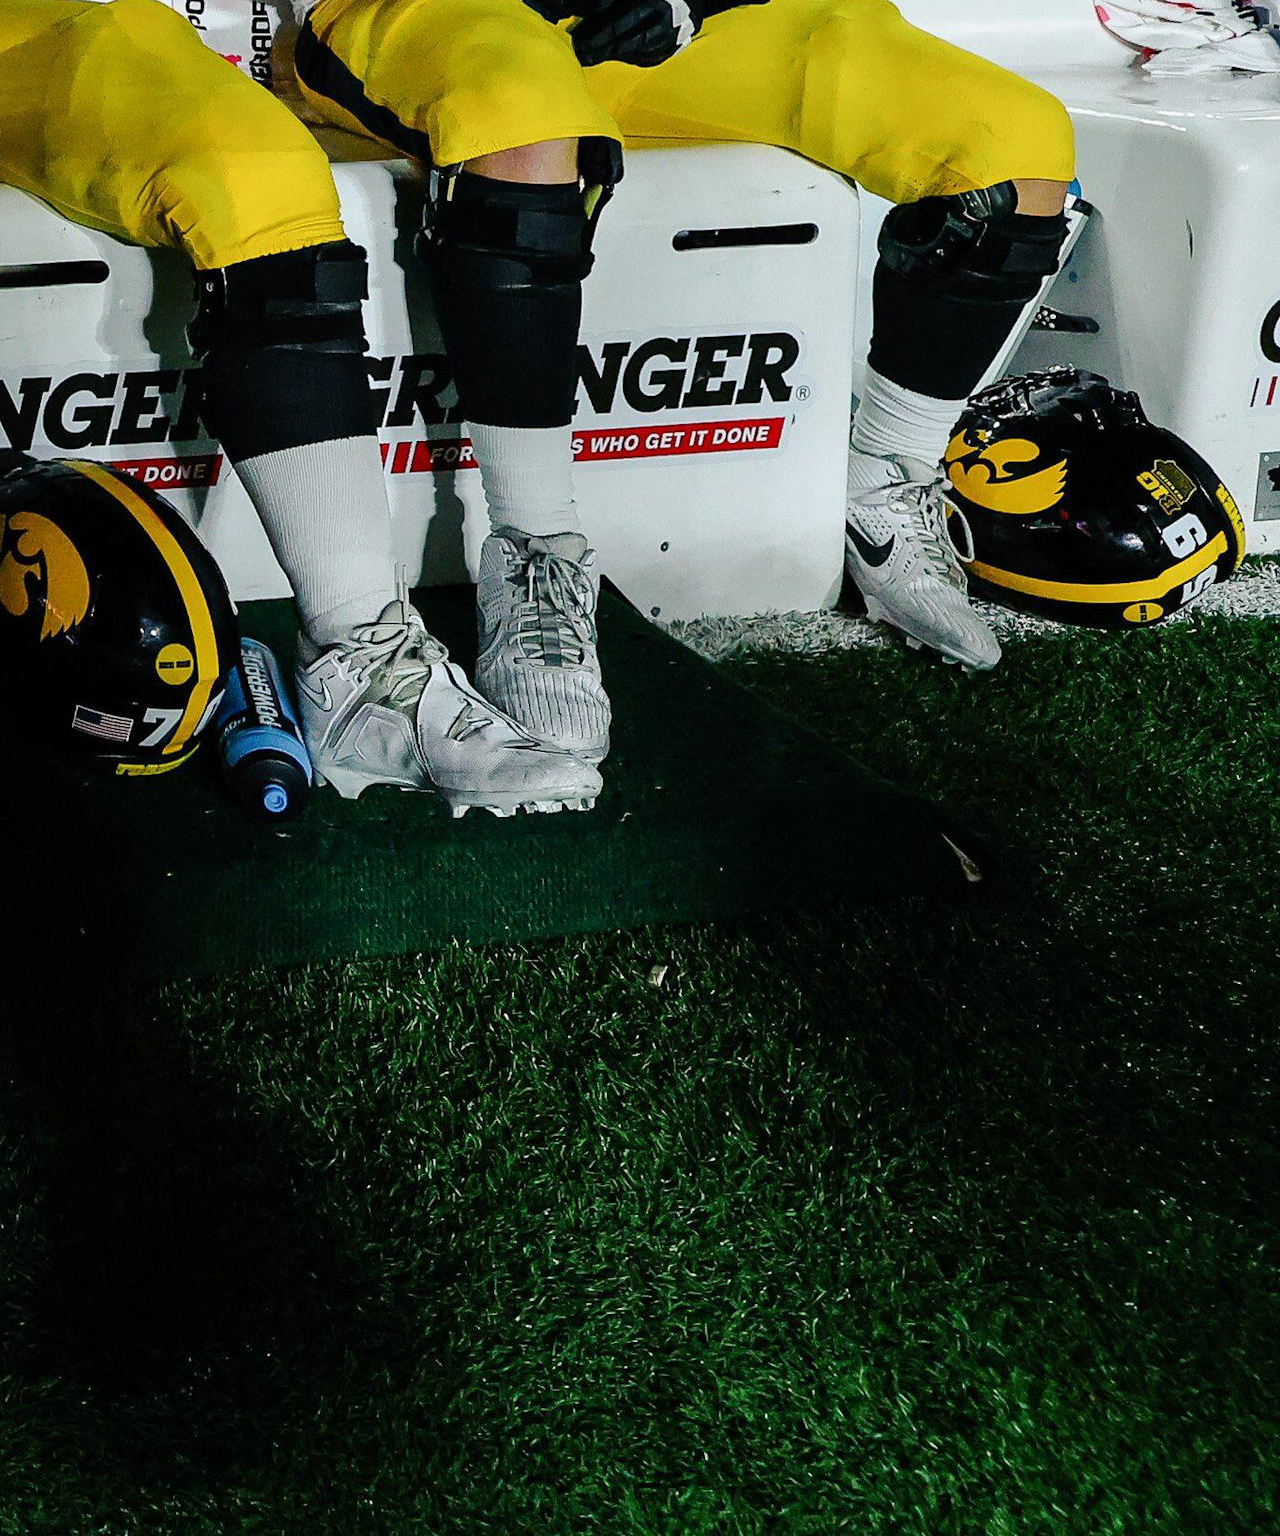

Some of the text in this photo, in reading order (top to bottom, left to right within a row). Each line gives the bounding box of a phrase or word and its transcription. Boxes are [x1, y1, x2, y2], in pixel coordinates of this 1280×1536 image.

[590, 434, 640, 453] WHO
[645, 430, 685, 449] GET
[688, 428, 706, 447] IT
[712, 425, 769, 445] DONE
[143, 464, 206, 482] DONE
[240, 648, 285, 727] POWERADE
[140, 709, 184, 748] 7
